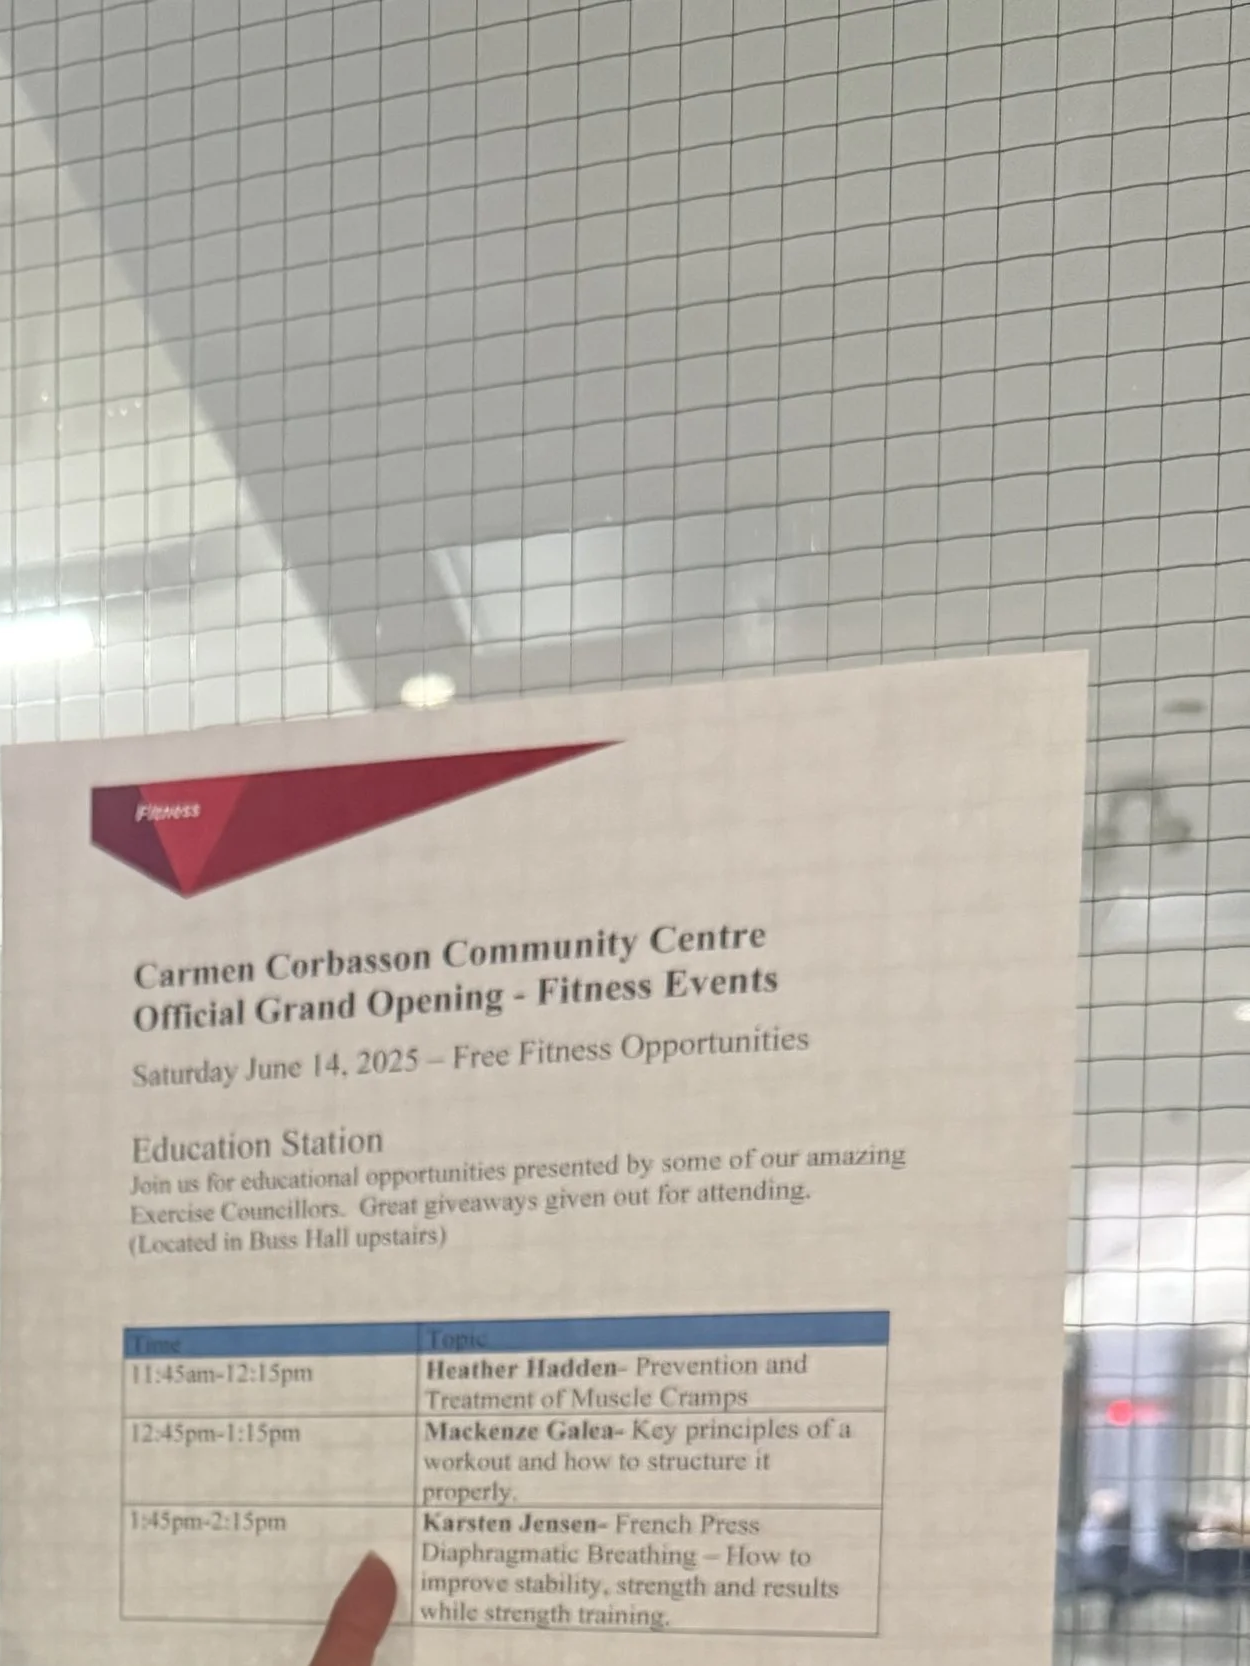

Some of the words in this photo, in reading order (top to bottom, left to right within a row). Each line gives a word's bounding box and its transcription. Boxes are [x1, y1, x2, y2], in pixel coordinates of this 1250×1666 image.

[134, 803, 201, 823] Fitness
[134, 961, 255, 990] Carmen
[265, 949, 432, 981] Corbasson
[443, 929, 637, 968] Community
[650, 924, 767, 954] Centre
[133, 999, 244, 1032] Official
[254, 992, 356, 1025] Grand
[367, 983, 504, 1023] Opening
[538, 975, 652, 1006] Fitness
[665, 967, 779, 998] Events
[132, 1057, 238, 1089] Saturday
[245, 1056, 302, 1083] June
[356, 1047, 419, 1075] 2025
[453, 1044, 510, 1070] Free
[518, 1039, 612, 1066] Fitness
[621, 1026, 809, 1064] Opportunities
[132, 1132, 271, 1163] Education
[281, 1127, 384, 1157] Station
[129, 1174, 171, 1196] Join
[177, 1177, 200, 1193] us
[206, 1172, 236, 1193] for
[240, 1167, 359, 1191] educational
[365, 1161, 506, 1190] opportunities
[513, 1154, 619, 1185] presented
[626, 1154, 654, 1179] by
[661, 1155, 722, 1173] some
[728, 1148, 757, 1170] of
[760, 1151, 800, 1169] our
[805, 1144, 907, 1170] amazing
[130, 1204, 215, 1225] Exercise
[220, 1198, 346, 1222] Councillors.
[358, 1196, 418, 1217] Great
[423, 1192, 538, 1220] giveaways
[544, 1188, 606, 1215] given
[613, 1188, 648, 1205] out
[657, 1183, 690, 1205] for
[697, 1176, 812, 1206] attending.
[128, 1232, 217, 1259] (Located
[224, 1231, 243, 1252] in
[249, 1229, 298, 1250] Buss
[305, 1226, 349, 1249] Hall
[355, 1225, 447, 1252] upstairs)
[133, 1333, 182, 1355] Time
[427, 1328, 488, 1351] Topic
[131, 1363, 313, 1387] 11:45am-12:15pm
[426, 1358, 518, 1380] Heather
[636, 1354, 758, 1376] Prevention
[766, 1352, 809, 1375] and
[424, 1388, 534, 1411] Treatment
[540, 1387, 568, 1409] of
[570, 1386, 653, 1409] Muscle
[660, 1385, 748, 1412] Cramps
[131, 1422, 302, 1447] 12:45pm-1:15pm
[424, 1420, 540, 1442] Mackenze
[632, 1418, 678, 1445] Key
[685, 1416, 799, 1445] principles
[807, 1417, 836, 1440] of
[838, 1425, 852, 1440] a
[423, 1450, 512, 1472] workout
[517, 1450, 558, 1472] and
[563, 1450, 611, 1472] how
[619, 1452, 640, 1472] to
[647, 1452, 747, 1472] structure
[755, 1448, 771, 1471] it
[422, 1480, 518, 1508] properly.
[130, 1510, 287, 1536] 1:45pm-2:15pm
[422, 1512, 513, 1534] Karsten
[615, 1512, 692, 1535] French
[700, 1513, 761, 1536] Press
[420, 1542, 580, 1569] Diaphragmatic
[586, 1543, 698, 1571] Breathing
[725, 1544, 782, 1567] How
[789, 1548, 812, 1567] to
[420, 1572, 509, 1597] improve
[514, 1573, 610, 1600] stability,
[615, 1574, 707, 1601] strength
[713, 1576, 755, 1598] and
[762, 1576, 840, 1599] results
[420, 1601, 479, 1622] while
[483, 1604, 571, 1630] strength
[578, 1606, 670, 1633] training.
